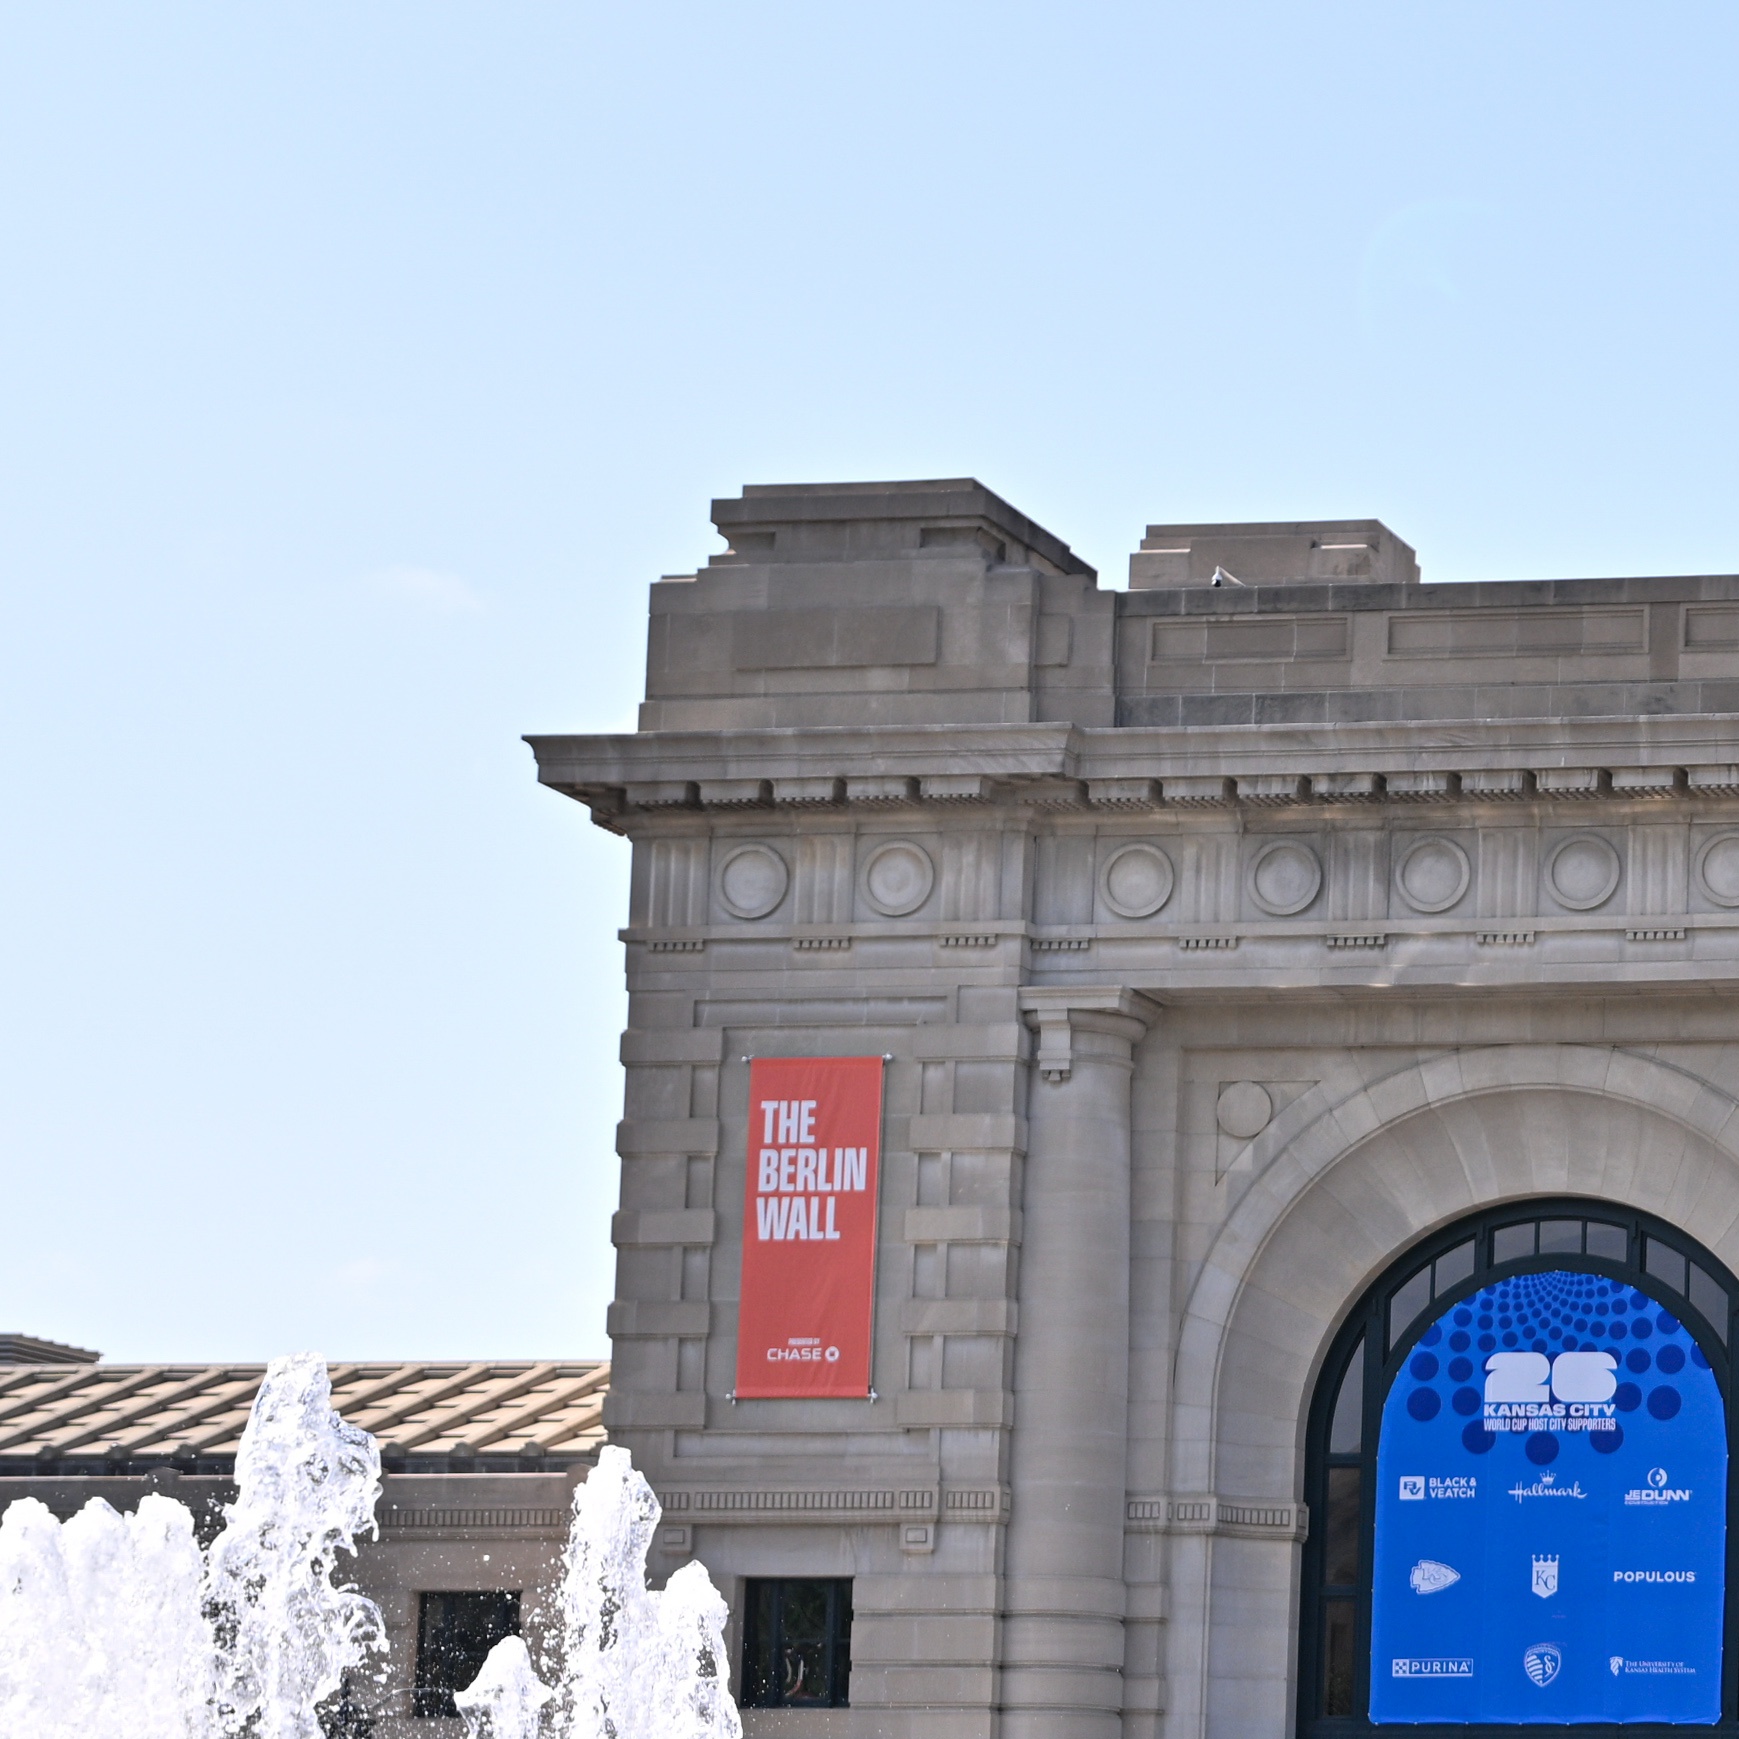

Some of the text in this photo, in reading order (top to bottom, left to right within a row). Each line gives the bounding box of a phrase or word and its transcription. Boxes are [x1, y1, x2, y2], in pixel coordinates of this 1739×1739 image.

[761, 1100, 817, 1144] THE
[758, 1147, 868, 1192] BERLIN
[756, 1196, 841, 1240] WALL
[767, 1347, 822, 1361] CHASE
[1484, 1351, 1618, 1402] 26
[1483, 1403, 1616, 1417] KANSAS CITY
[1483, 1418, 1616, 1431] WORLD CUP HOST CITY SUPPORTERS
[1429, 1477, 1477, 1487] BLACK &
[1429, 1488, 1475, 1498] VEATCH
[1508, 1481, 1588, 1504] Hallmark
[1535, 1570, 1555, 1590] KC
[1613, 1571, 1696, 1582] POPULOUS
[1411, 1662, 1469, 1673] PURINA
